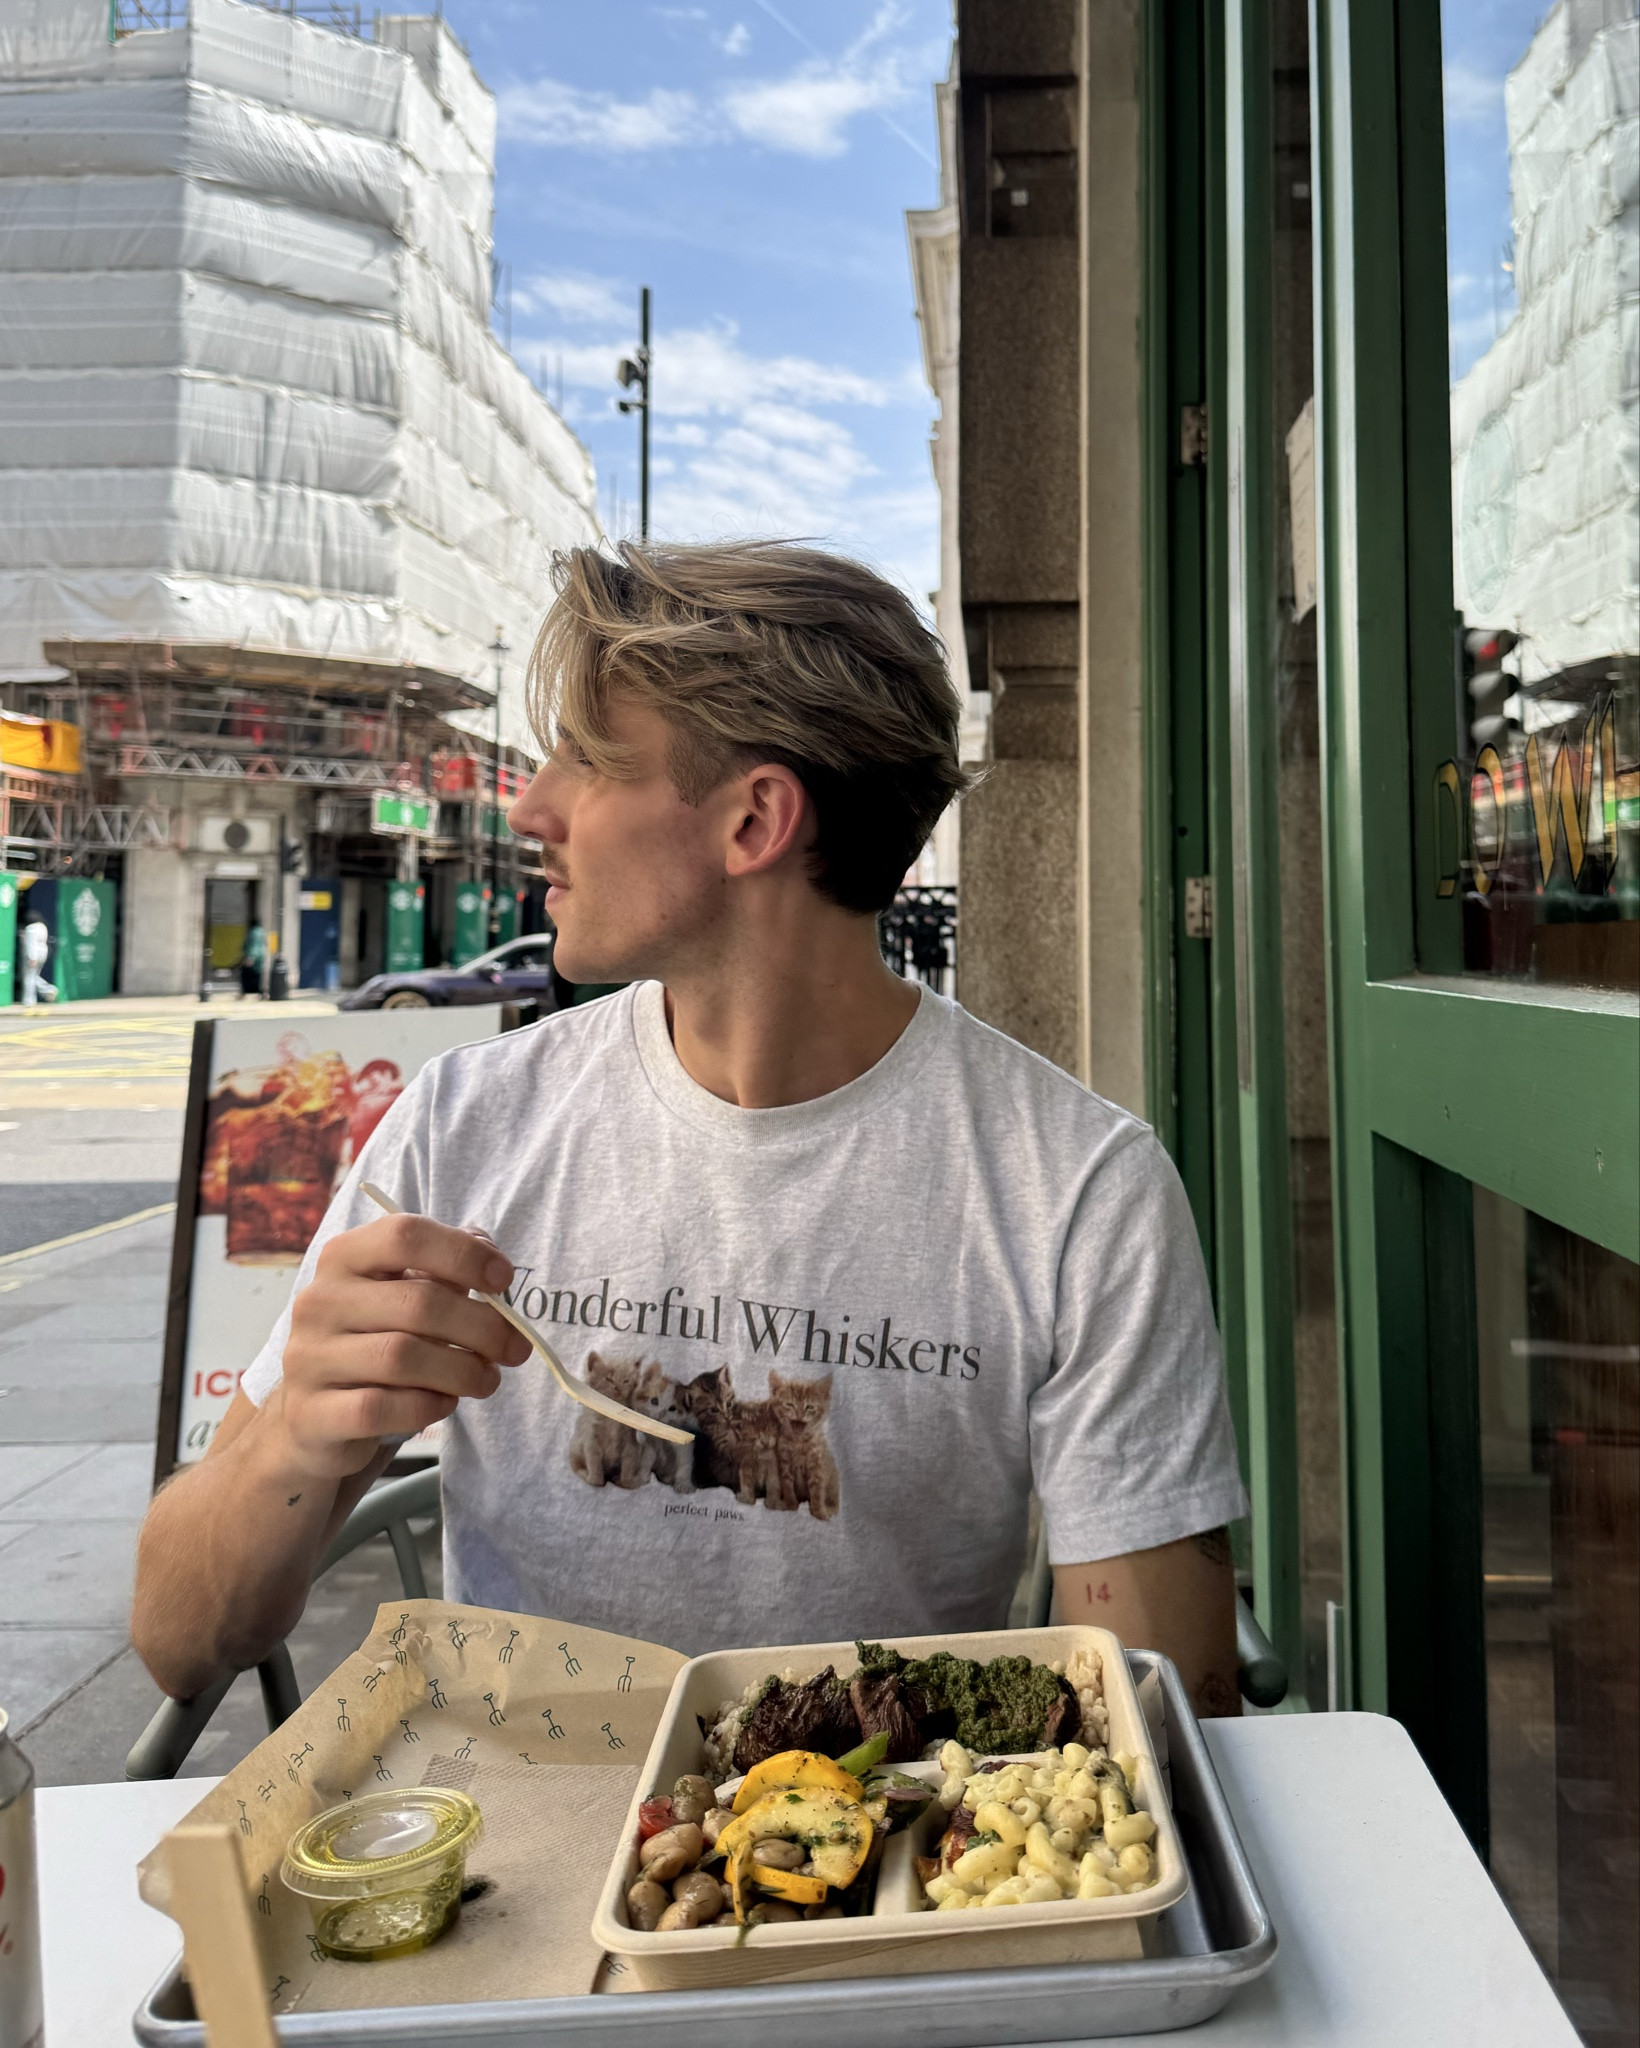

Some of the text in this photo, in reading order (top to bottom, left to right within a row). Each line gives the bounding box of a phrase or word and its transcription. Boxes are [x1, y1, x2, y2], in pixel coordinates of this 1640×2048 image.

[737, 1299, 981, 1382] Whiskers
[663, 1502, 708, 1517] perfect
[1086, 1582, 1111, 1605] 14
